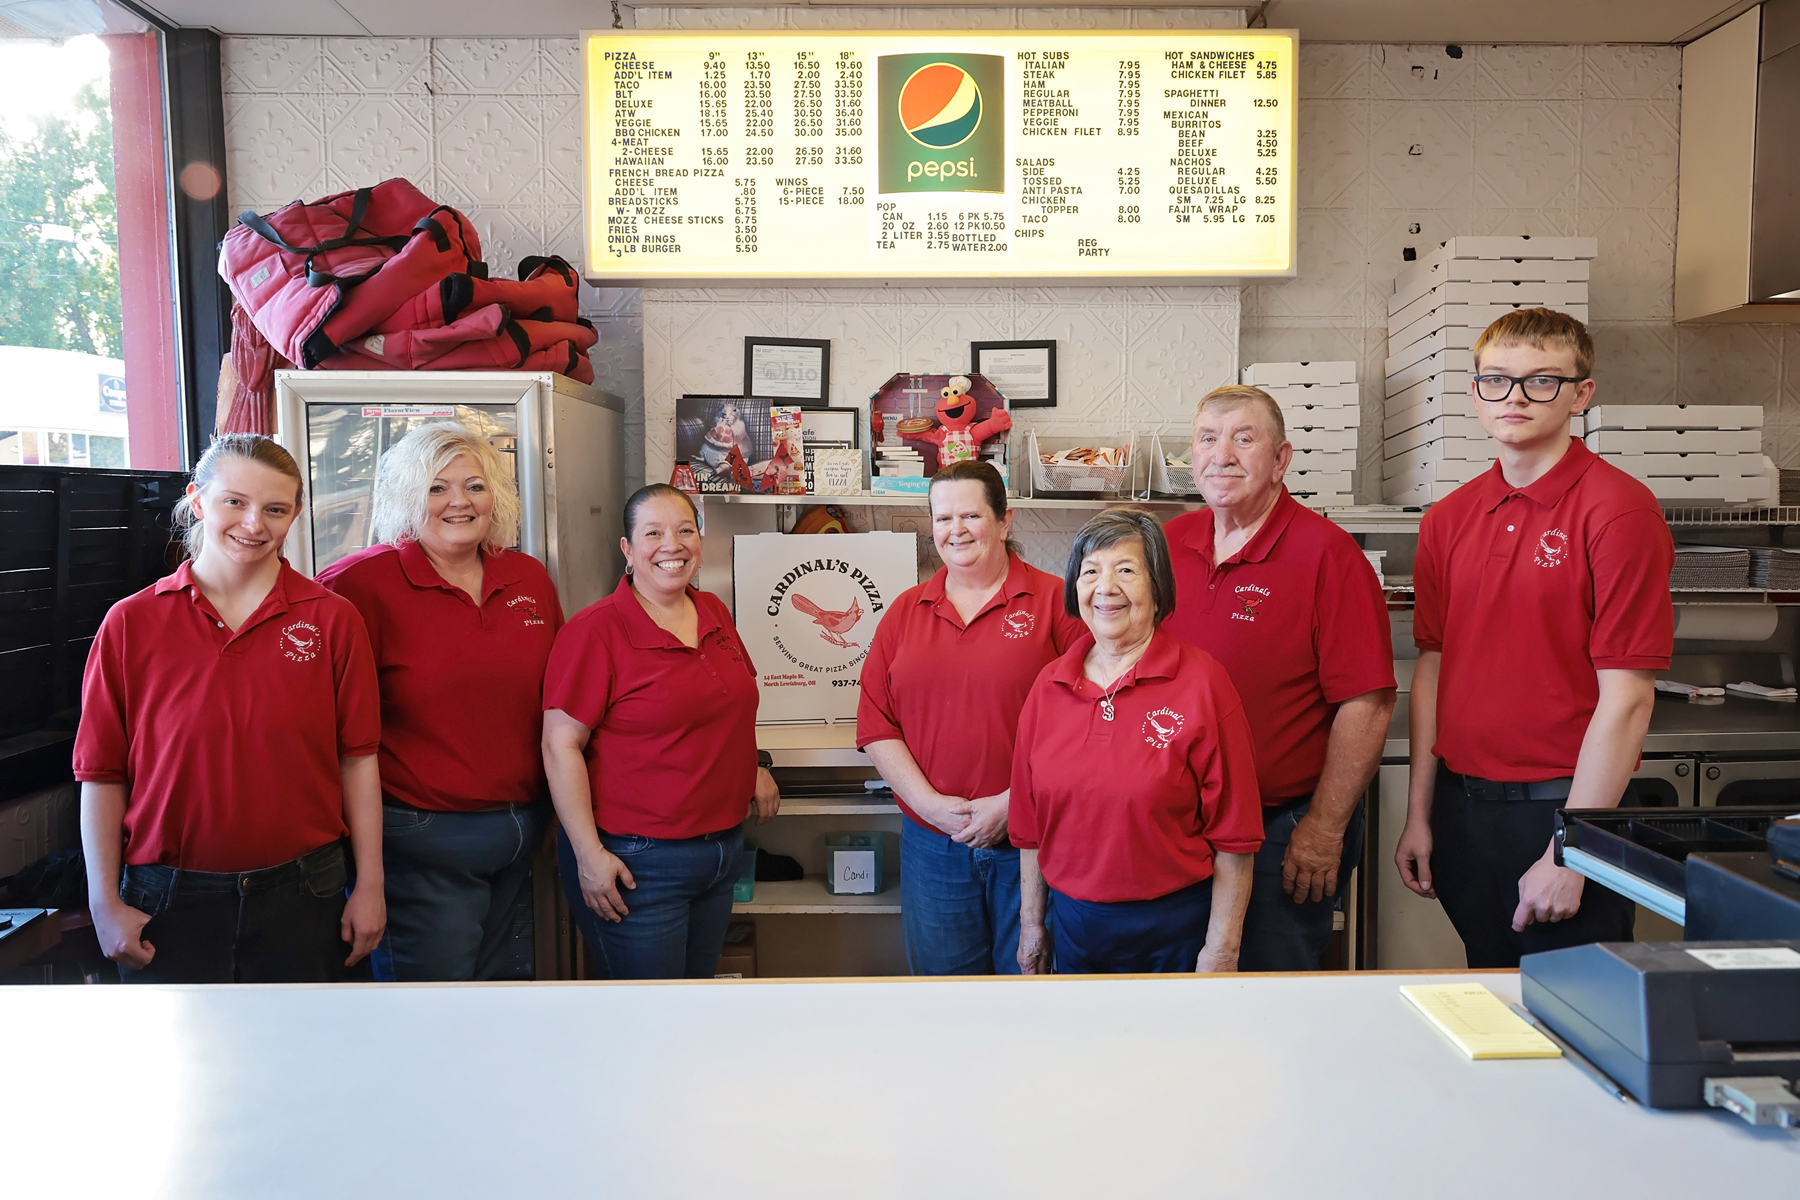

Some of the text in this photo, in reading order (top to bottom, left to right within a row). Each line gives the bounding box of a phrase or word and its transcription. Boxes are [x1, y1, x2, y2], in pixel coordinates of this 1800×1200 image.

[604, 52, 636, 60] PIZZA
[1018, 52, 1070, 60] HOT SUBS
[1164, 50, 1254, 60] HOT SANDWICHES
[614, 60, 862, 70] CHEESE 9.40 13.50 16.50 19.60
[1026, 60, 1140, 70] ITALIAN 7.95
[1172, 60, 1278, 70] HAM & CHEESE 4.75
[614, 70, 726, 80] ADD'L ITEM 1.25
[1022, 70, 1056, 80] STEAK
[1170, 70, 1278, 80] CHICKEN FILET 5.85
[614, 80, 726, 90] TACO 16.00
[1024, 80, 1046, 88] HAM
[616, 90, 634, 98] BLT
[1024, 90, 1070, 98] REGULAR
[1164, 88, 1218, 98] SPAGHETTI
[614, 100, 728, 108] DELUXE 15.65
[1022, 98, 1074, 108] MEATBALL
[1190, 98, 1278, 108] DINNER 12.50
[614, 108, 726, 118] ATW 18.15
[1022, 108, 1078, 116] PEPPERONI
[1164, 110, 1208, 120] MEXICAN
[616, 118, 652, 128] VEGGIE
[1022, 118, 1058, 126] VEGGIE
[1170, 120, 1222, 128] BURRITOS
[616, 128, 728, 138] BBQ CHICKEN 17.00
[1022, 128, 1140, 136] CHICKEN FILET 8.95
[1178, 130, 1278, 138] BEAN 3.25
[612, 138, 648, 146] 4-MEAT
[1178, 138, 1278, 148] BEEF 4.50
[622, 146, 674, 156] 2-CHEESE
[1178, 148, 1278, 158] DELUXE 5.25
[614, 156, 664, 166] HAWAIIAN
[1016, 158, 1056, 166] SALADS
[1170, 158, 1212, 166] NACHOS
[608, 168, 724, 178] FRENCH BREAD PIZZA
[907, 157, 975, 182] pepsi
[1022, 166, 1140, 176] SIDE 4.25
[1178, 166, 1226, 176] REGULAR
[614, 178, 654, 186] CHEESE
[776, 178, 808, 186] WINGS
[1022, 176, 1062, 186] TOSSED
[1178, 176, 1278, 186] DELUXE 5.50
[614, 188, 678, 196] ADD'L ITEM
[782, 186, 864, 196] 6-PIECE 7.50
[1022, 186, 1140, 196] ANTI PASTA 7.00
[1168, 186, 1240, 194] QUESADILLAS
[608, 196, 678, 206] BREADSTICKS
[778, 196, 864, 206] 15-PIECE 18.00
[1022, 196, 1066, 204] CHICKEN
[636, 206, 666, 216] MOZZ
[876, 202, 896, 212] POP
[1040, 204, 1140, 214] TOPPER 8.00
[1168, 204, 1238, 214] FAJITA WRAP
[608, 216, 724, 224] MOZZ CHEESE STICKS
[882, 212, 948, 220] CAN 1.15
[1022, 214, 1048, 224] TACO
[608, 226, 638, 234] FRIES
[882, 222, 948, 230] 20 OZ 2.60
[882, 230, 950, 240] 2 LITER 3.55
[952, 234, 996, 242] BOTTLED
[1014, 228, 1044, 238] CHIPS
[608, 234, 676, 244] ONION RINGS
[1078, 238, 1098, 248] REG
[624, 244, 682, 254] LB BURGER
[876, 240, 950, 250] TEA 2.75
[1078, 248, 1110, 256] PARTY
[828, 478, 847, 486] PIZZA
[898, 480, 920, 488] Singing
[1534, 556, 1561, 568] Pizza
[766, 558, 884, 617] CARDINAL'S PIZZA
[1234, 584, 1270, 596] Cardinals
[1231, 612, 1254, 622] Pizza
[282, 620, 321, 636] Cardinal's
[1004, 630, 1029, 638] Pizza
[284, 650, 316, 662] Pizza
[773, 636, 798, 664] SERVING
[798, 661, 823, 673] GREAT
[826, 664, 848, 674] PIZZA
[1146, 706, 1185, 726] Cardinal's
[1144, 736, 1169, 748] Pizz
[844, 866, 870, 882] Candi
